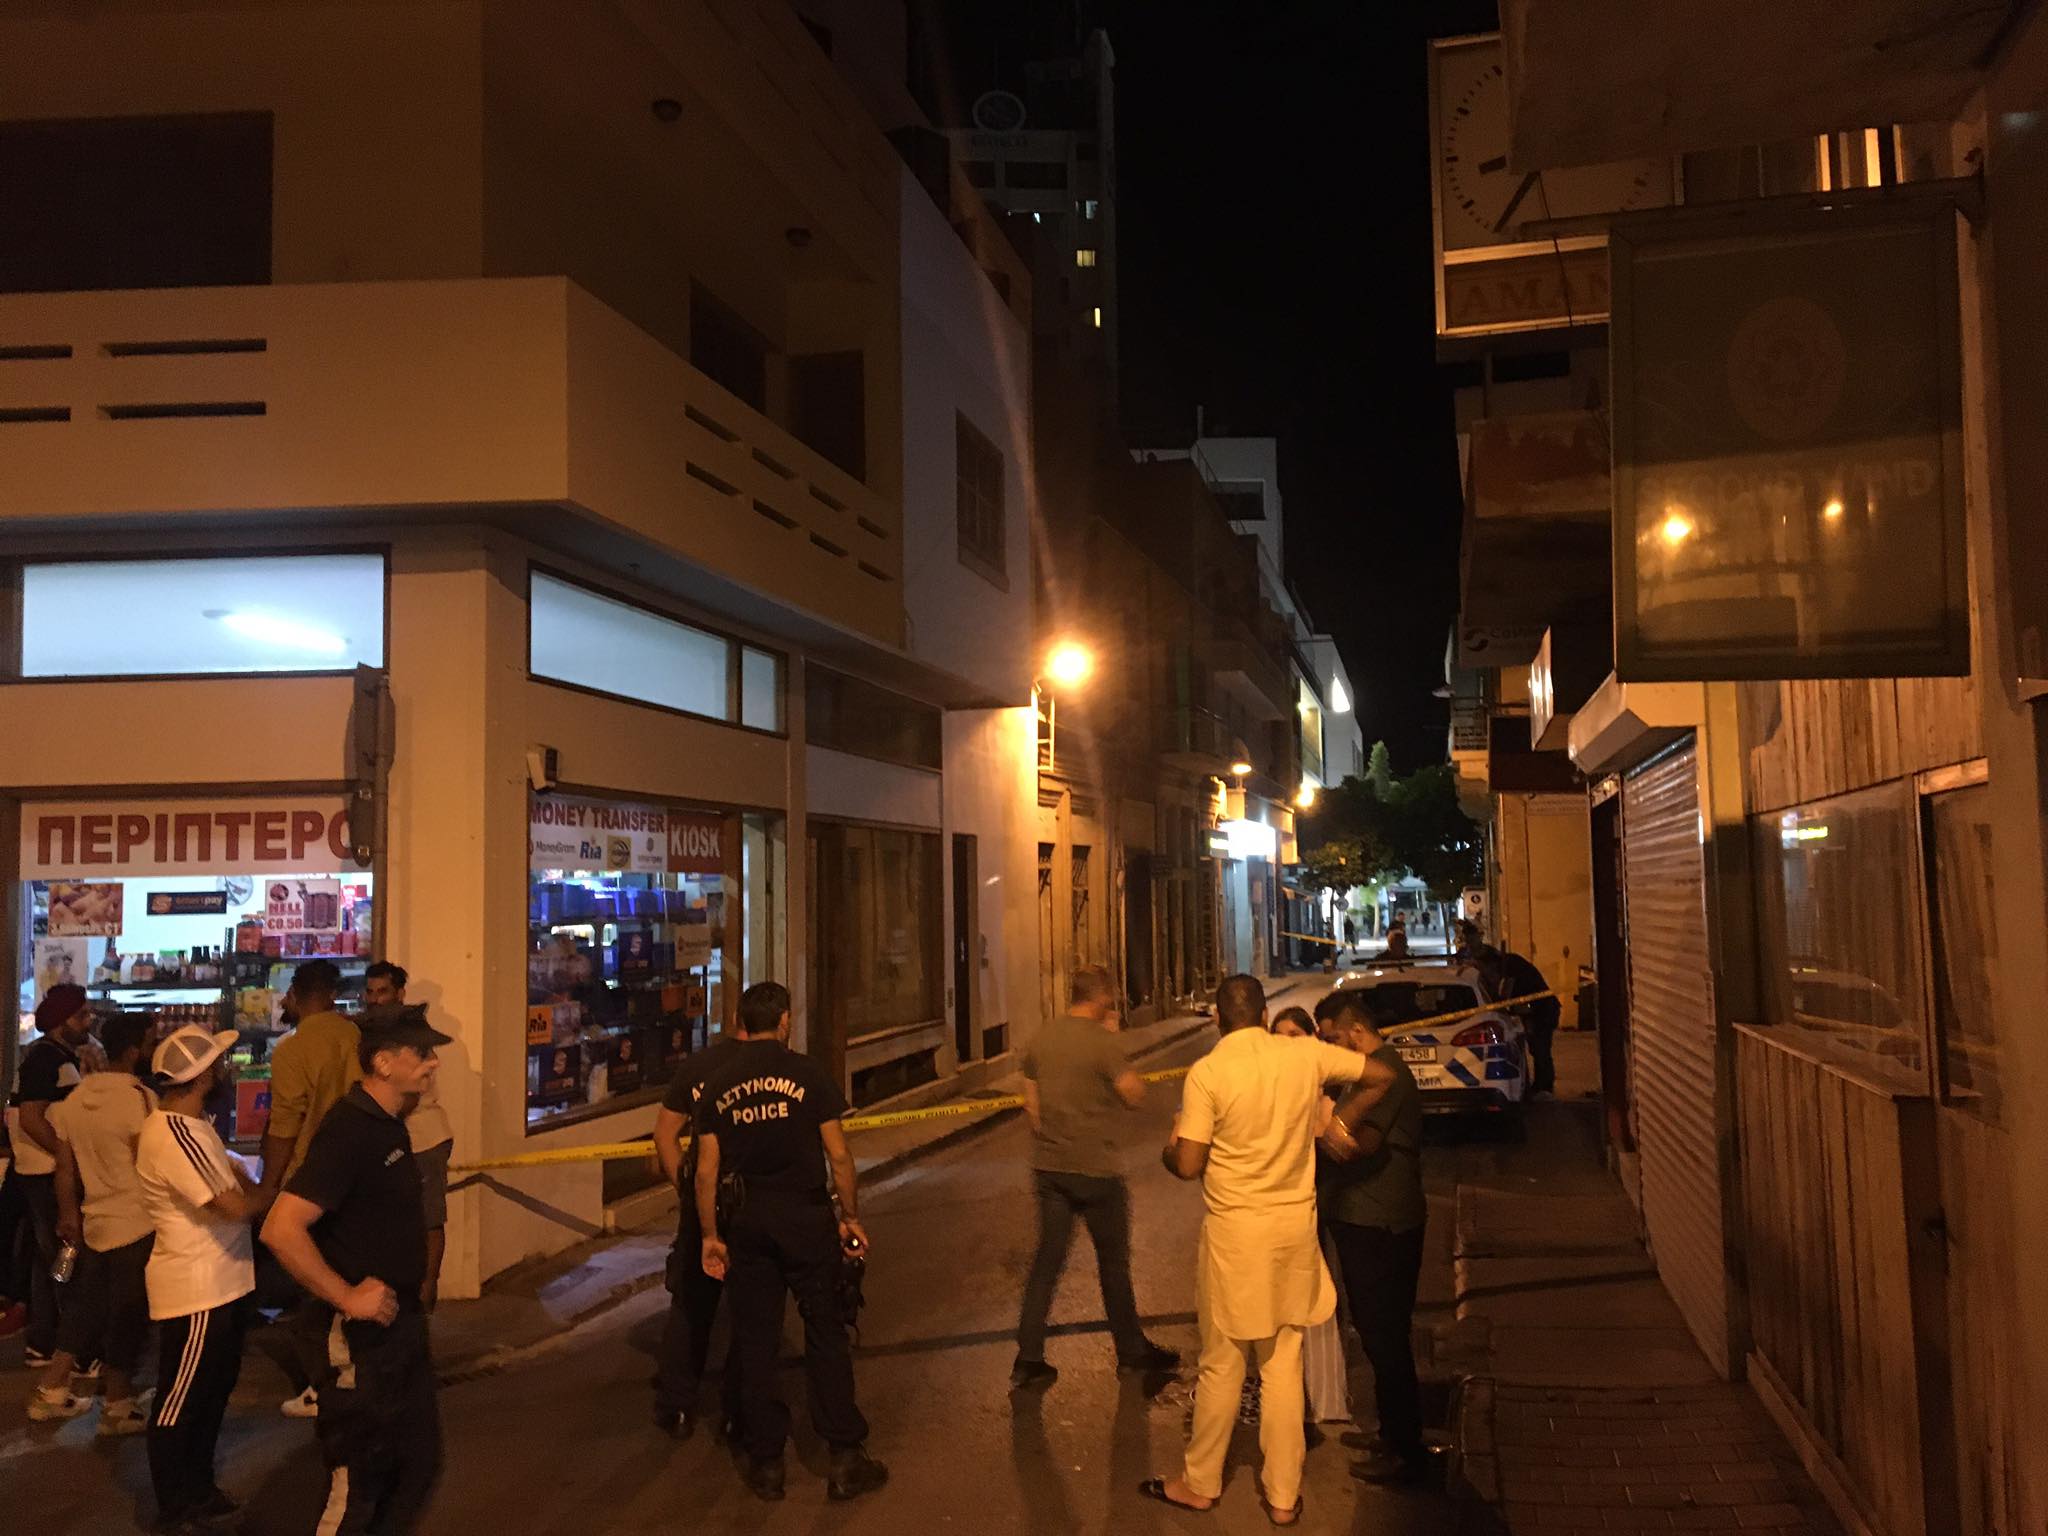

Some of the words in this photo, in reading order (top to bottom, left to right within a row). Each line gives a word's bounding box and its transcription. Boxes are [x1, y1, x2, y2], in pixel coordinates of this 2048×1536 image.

[531, 802, 586, 828] MONEY
[591, 807, 666, 834] TRANSFER
[580, 840, 602, 859] Ria
[670, 823, 721, 859] KIOSK
[732, 1101, 789, 1125] POLICE
